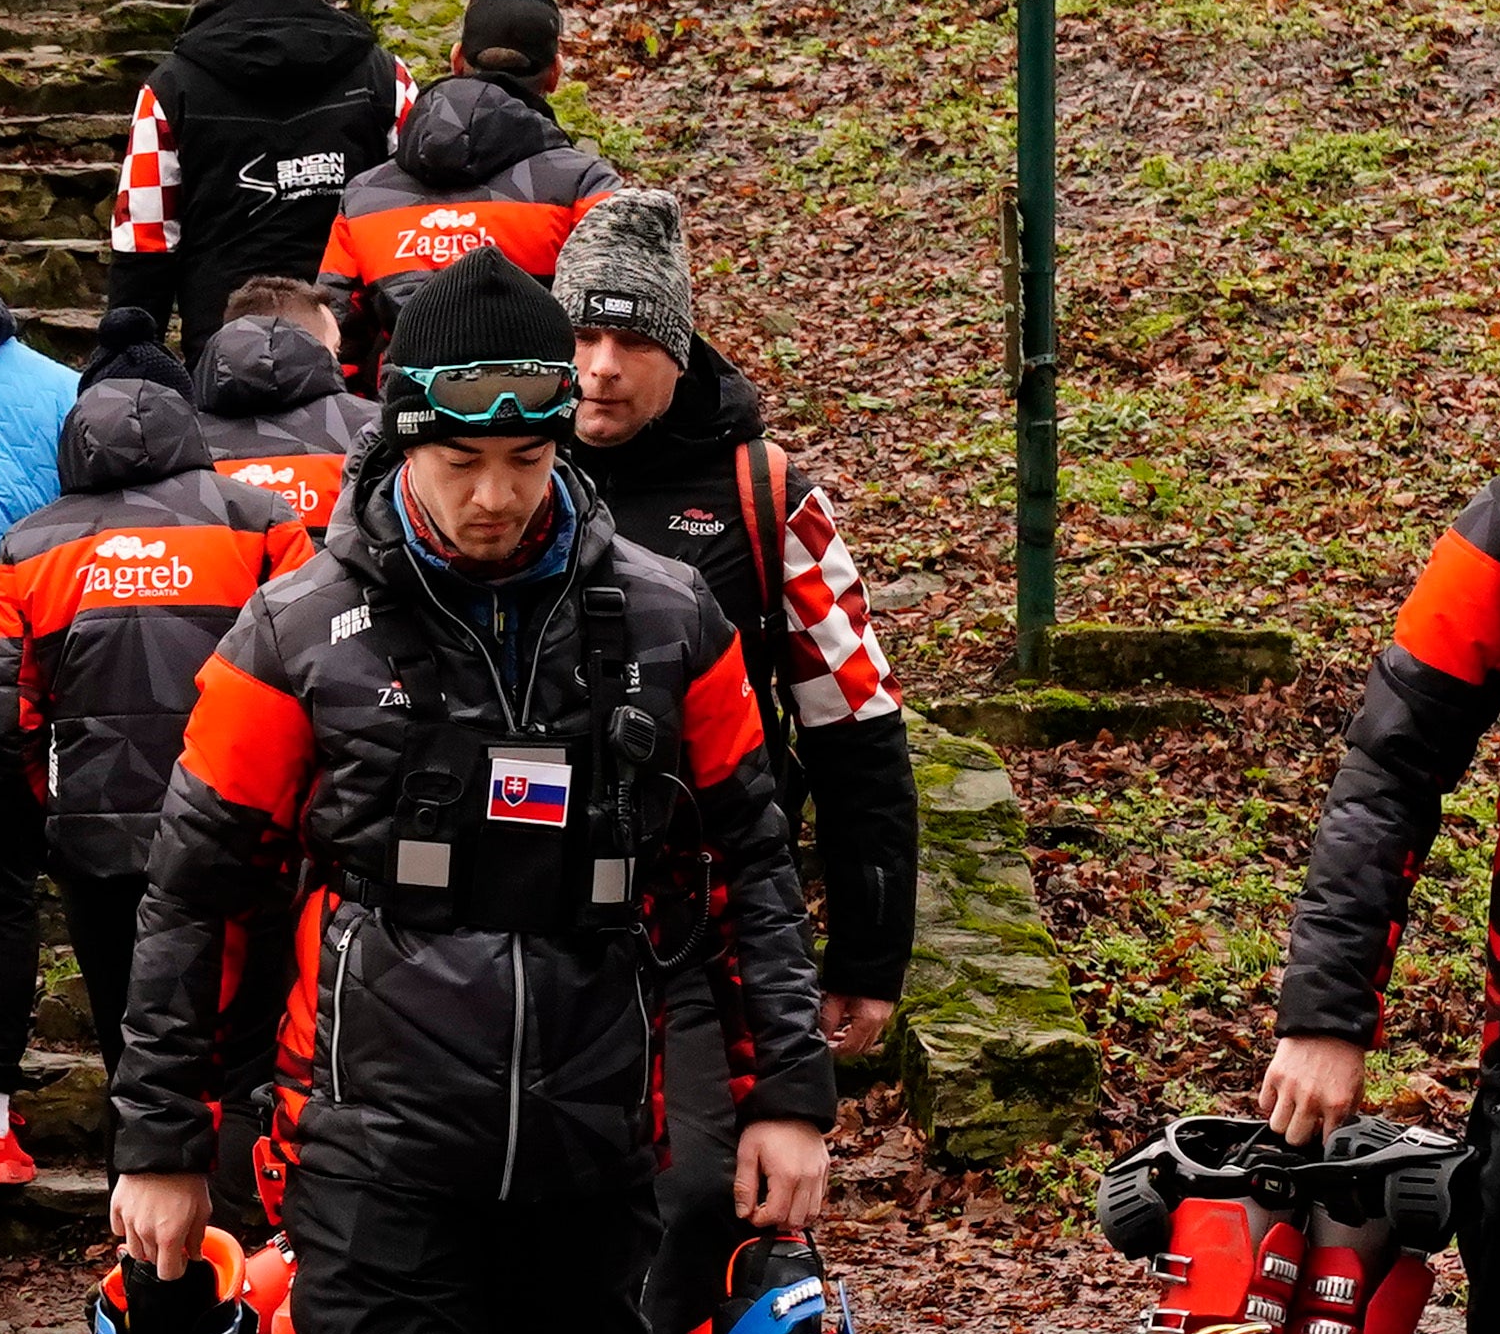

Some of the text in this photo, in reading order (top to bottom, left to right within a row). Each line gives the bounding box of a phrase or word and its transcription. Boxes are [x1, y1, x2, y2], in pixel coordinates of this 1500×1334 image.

[277, 152, 345, 171] SNOW
[277, 163, 345, 180] QUEEN
[277, 173, 345, 190] TROPHY
[394, 227, 496, 263] Zagreb
[667, 515, 725, 536] Zagreb
[75, 556, 193, 598] Zagreb
[138, 589, 179, 597] CROATIA
[331, 604, 370, 633] ENER
